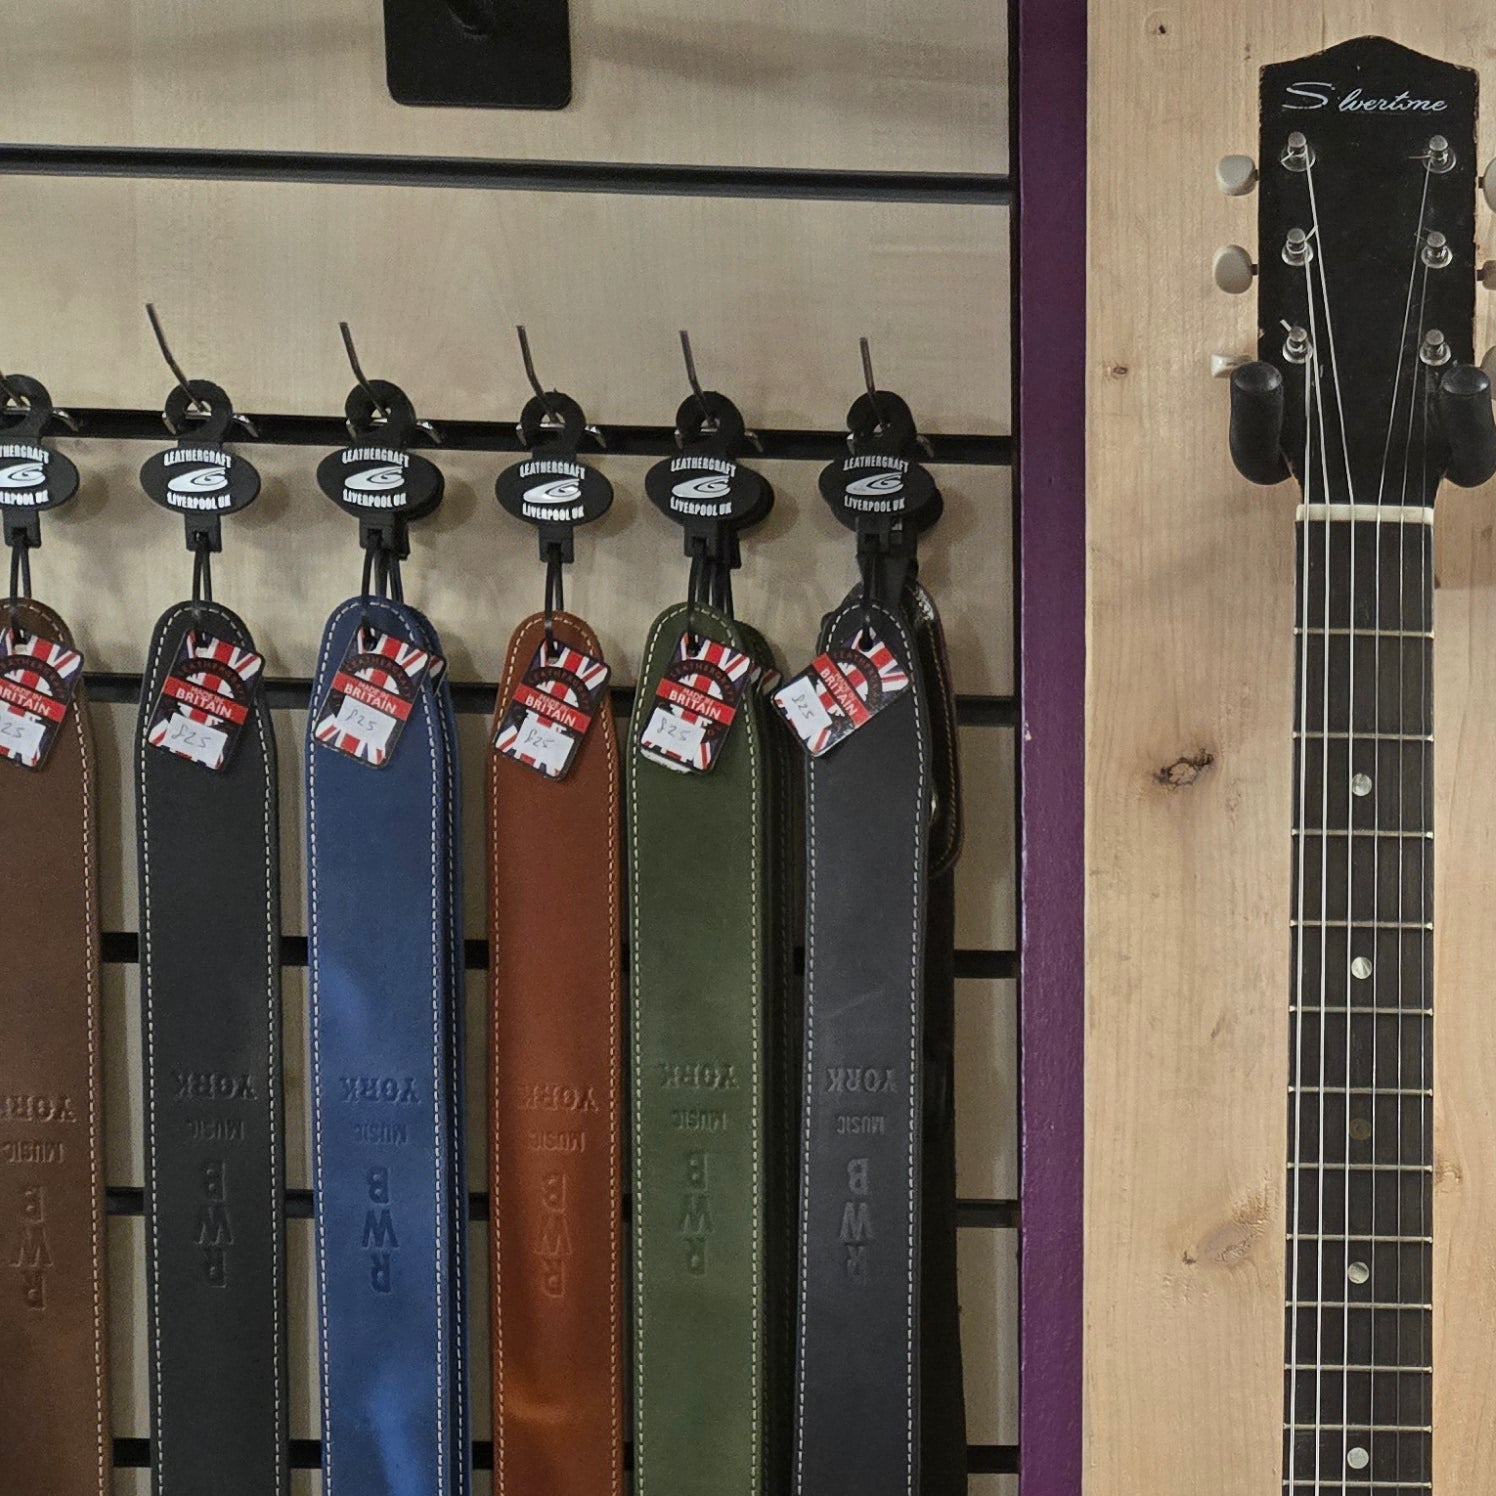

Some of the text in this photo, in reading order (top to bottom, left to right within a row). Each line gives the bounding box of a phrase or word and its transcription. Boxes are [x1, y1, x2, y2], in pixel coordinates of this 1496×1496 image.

[1282, 81, 1448, 112] Slvertone
[163, 449, 231, 468] LEATHERGRAFT
[342, 447, 409, 468] LEATHERGRAFT
[670, 457, 736, 477] LEATHERGRAFT
[843, 455, 909, 473] LEATHERGRAFT
[520, 461, 585, 480] LEATHERGRAFT
[166, 491, 231, 510] LIVERPOOL UK
[342, 488, 407, 508] LIVERPOOL UK
[670, 496, 732, 516] LIVERPOOL UK
[844, 495, 905, 512] LIVERPOOL UK
[522, 502, 584, 521] LIVERPOOL UK
[176, 687, 231, 718] BRITAIN
[343, 683, 397, 714] BRITAIN
[820, 668, 858, 716] BRITAIN
[525, 695, 576, 727] BRITAIN
[668, 690, 721, 720] BRITAIN
[0, 721, 24, 738] 25
[171, 724, 211, 748] £25
[657, 717, 691, 741] £25
[176, 1072, 258, 1100] YORK
[659, 1062, 740, 1091] YORK
[825, 1067, 897, 1095] YORK
[339, 1077, 422, 1106] YORK
[516, 1083, 600, 1113] YORK
